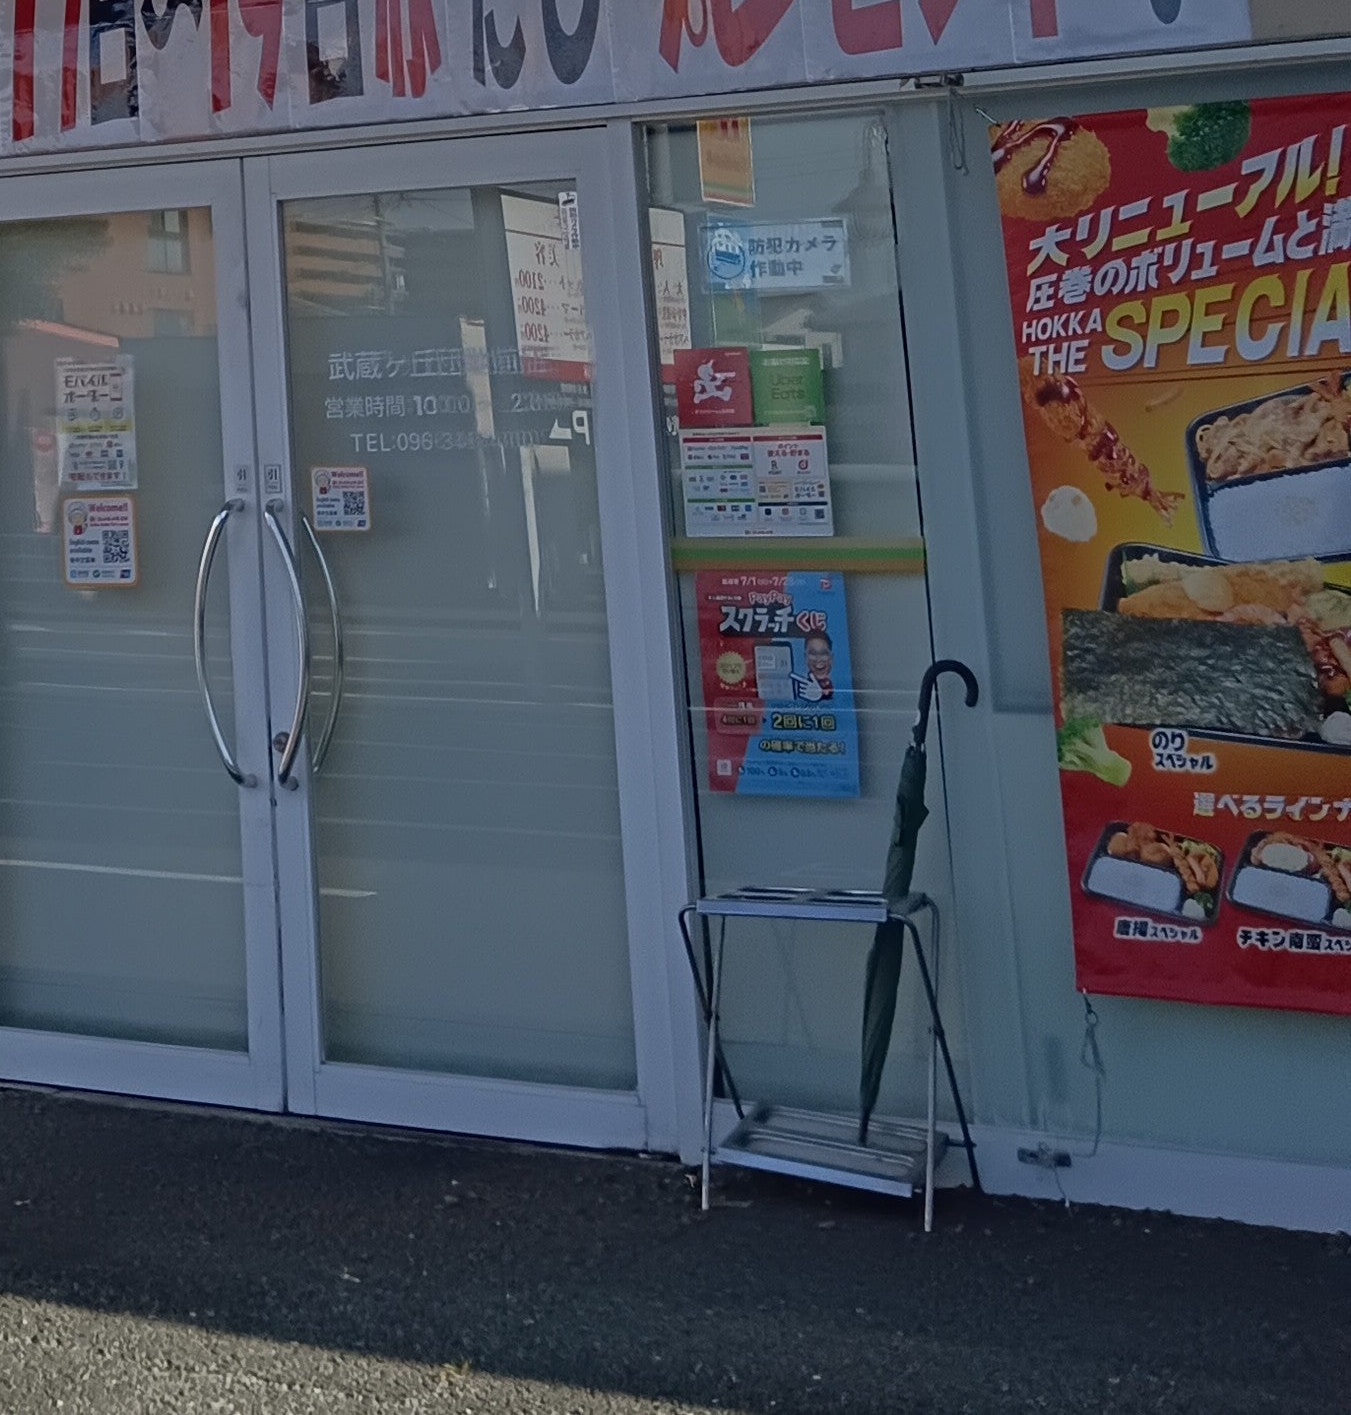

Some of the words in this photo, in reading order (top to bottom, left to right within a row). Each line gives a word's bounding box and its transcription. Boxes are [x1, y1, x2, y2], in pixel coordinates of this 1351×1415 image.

[748, 235, 837, 254] 防犯カメラ
[750, 259, 803, 277] 作動中
[1022, 308, 1103, 343] HOKKA
[1028, 340, 1089, 376] THE
[324, 394, 405, 418] 営業時間
[772, 712, 836, 730] 2回に1回
[1151, 731, 1186, 751] のり
[1154, 753, 1214, 770] スペシャル
